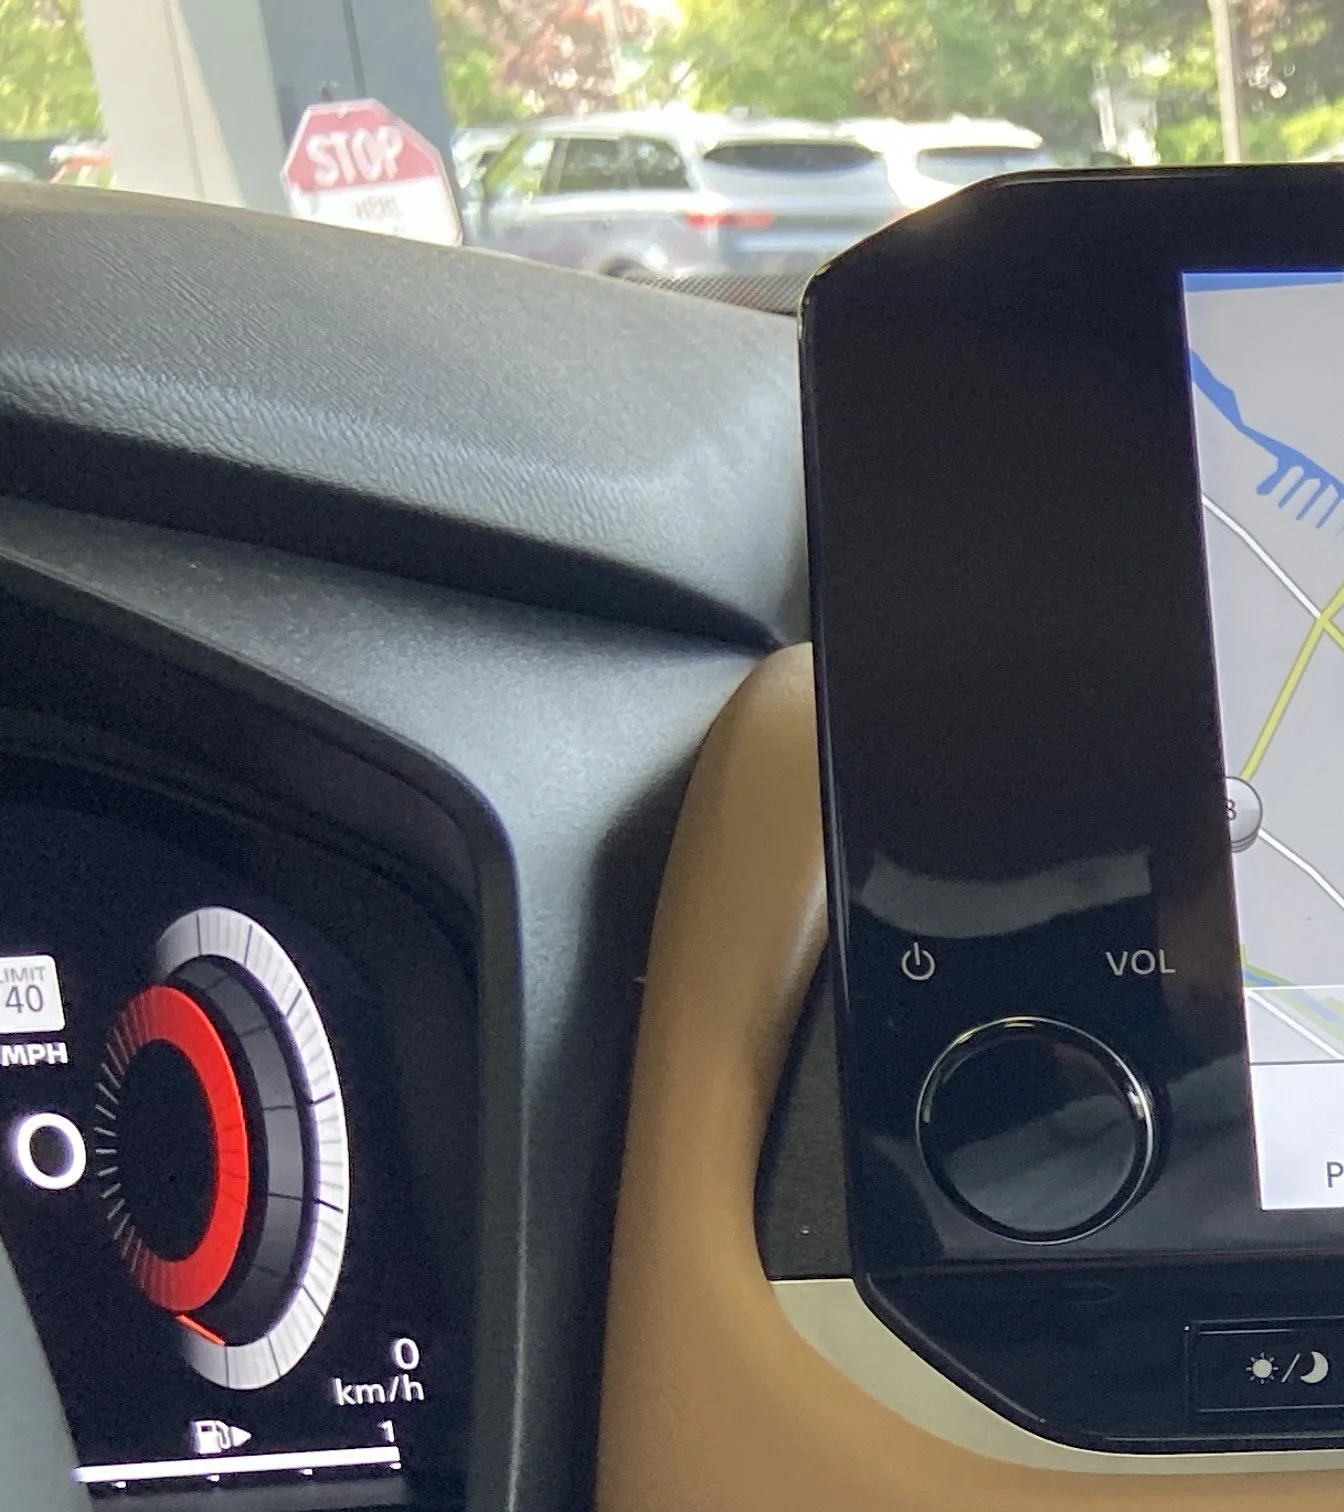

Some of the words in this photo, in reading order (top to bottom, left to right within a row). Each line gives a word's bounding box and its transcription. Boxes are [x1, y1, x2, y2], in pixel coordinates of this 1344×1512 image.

[306, 126, 404, 187] STOP
[0, 966, 45, 983] IMIT
[1106, 949, 1176, 976] VOL
[5, 985, 44, 1013] 40
[1, 1042, 69, 1067] MPH
[392, 1337, 420, 1371] 0
[334, 1374, 425, 1408] km/h
[380, 1420, 395, 1443] 1
